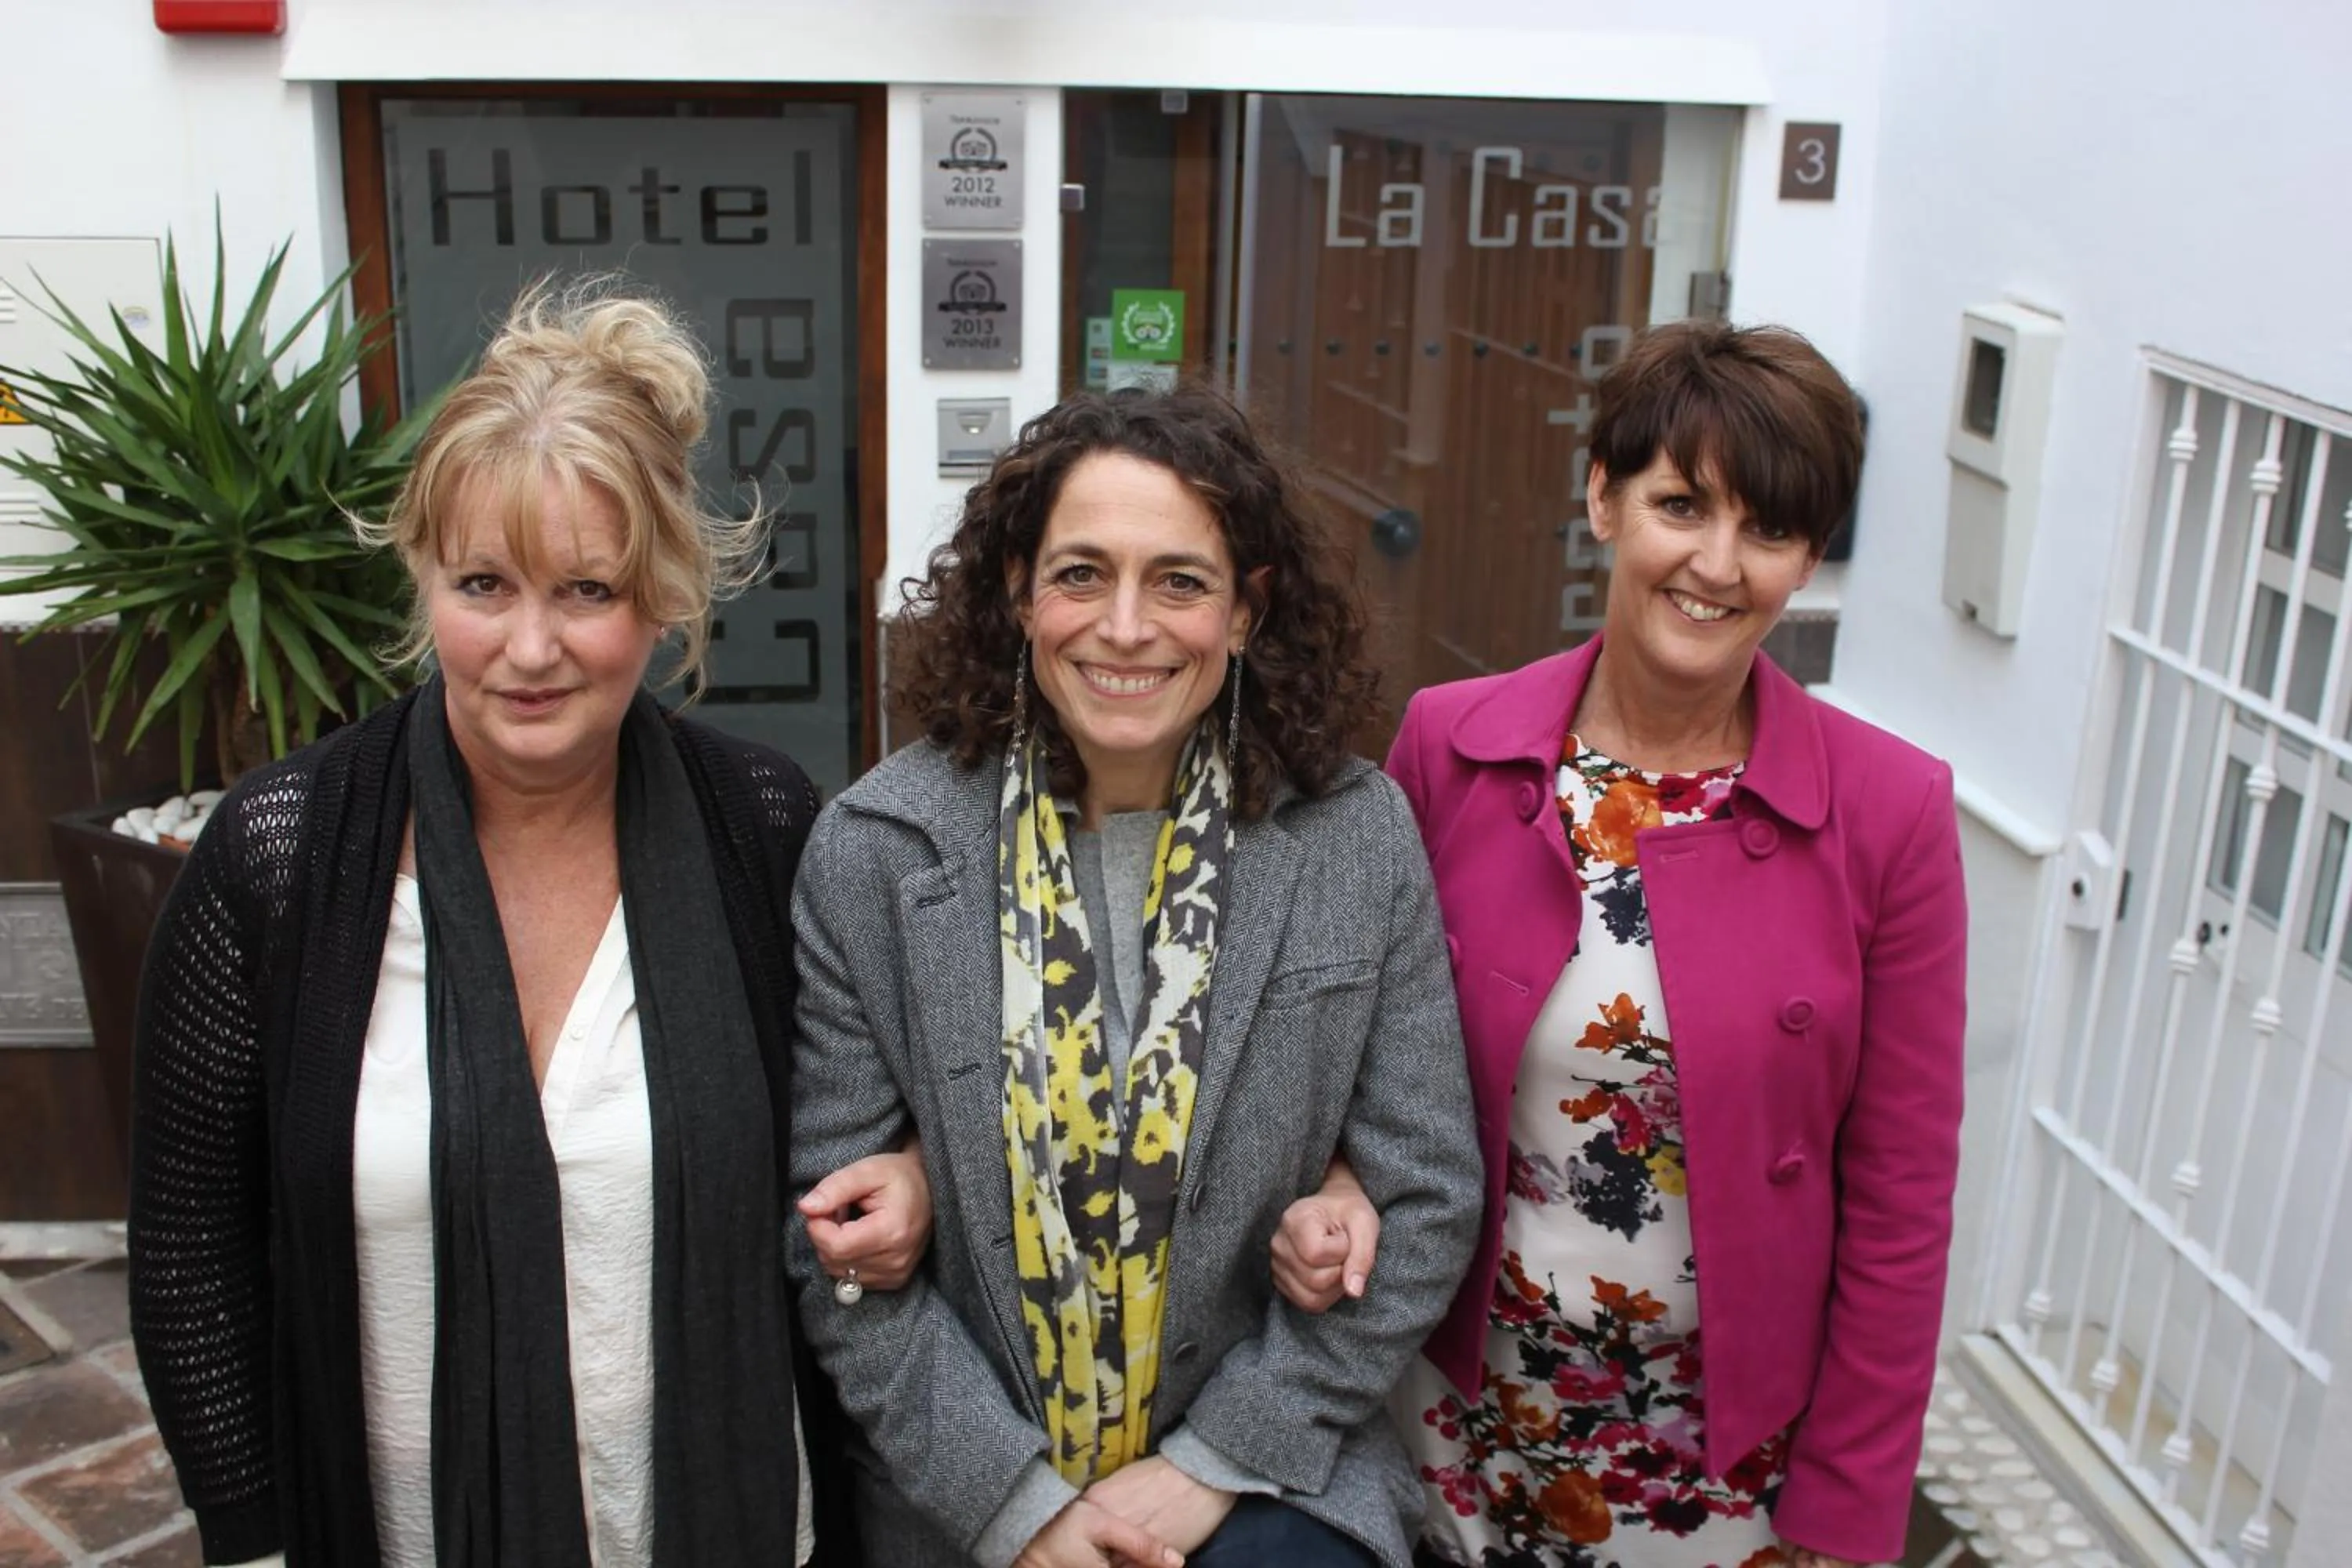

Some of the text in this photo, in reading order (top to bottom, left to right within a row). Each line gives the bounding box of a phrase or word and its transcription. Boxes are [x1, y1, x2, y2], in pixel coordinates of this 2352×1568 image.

[1795, 138, 1826, 184] 3
[951, 176, 996, 194] 2012
[427, 148, 813, 246] Hotel
[944, 195, 1003, 209] WINNER
[1325, 144, 1425, 248] La
[950, 319, 994, 336] 2013
[942, 337, 1002, 350] WINNER
